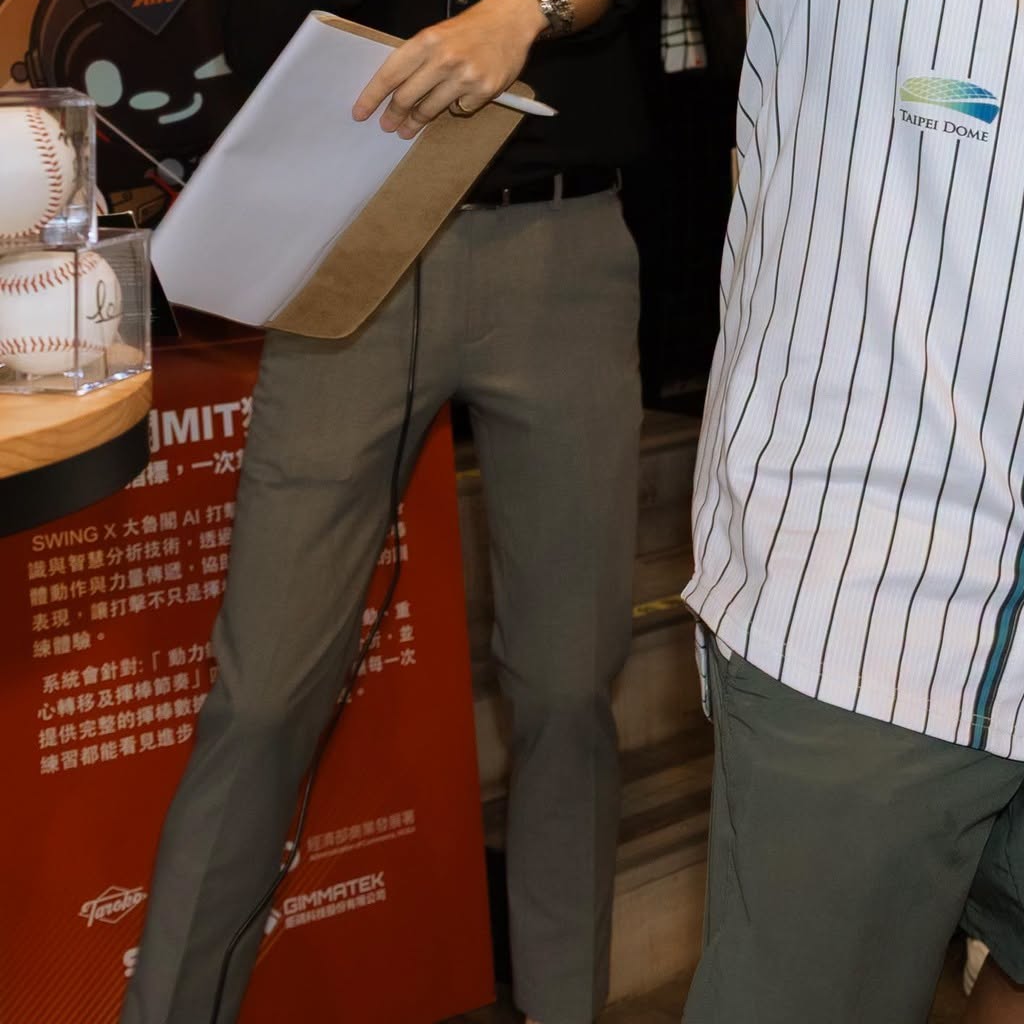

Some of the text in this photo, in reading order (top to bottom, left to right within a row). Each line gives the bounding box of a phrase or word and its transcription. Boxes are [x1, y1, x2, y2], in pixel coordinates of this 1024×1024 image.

[899, 109, 989, 143] TAIPEI DOME
[31, 526, 99, 553] SWING
[104, 524, 118, 541] X
[123, 512, 177, 538] 大魯閣
[183, 509, 200, 528] AI
[32, 578, 226, 632] 表現，讓打擊不只是揮
[40, 723, 194, 776] 練習都能看見進步
[79, 886, 149, 928] Taroko
[283, 871, 385, 916] GIMMATEK
